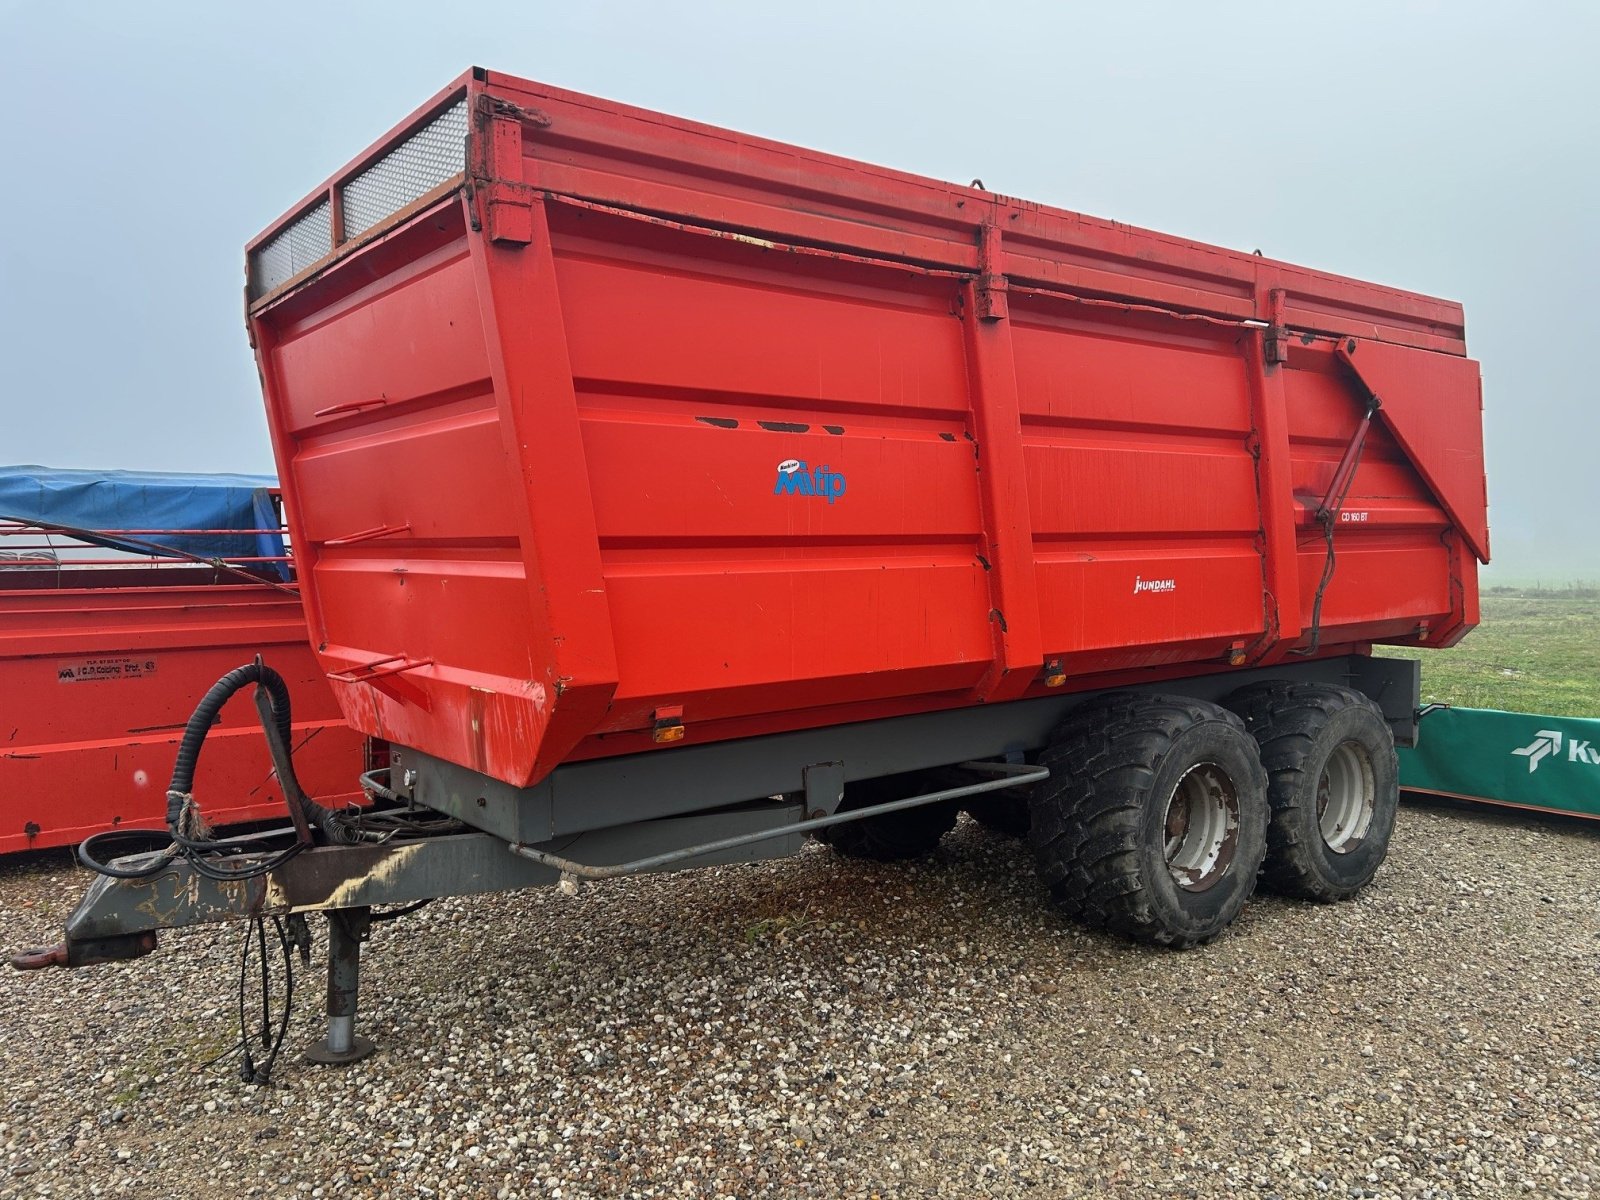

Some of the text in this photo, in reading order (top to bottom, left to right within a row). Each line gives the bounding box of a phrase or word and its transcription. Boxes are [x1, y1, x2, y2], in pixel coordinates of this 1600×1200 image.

[1341, 512, 1369, 522] CD 160 BT
